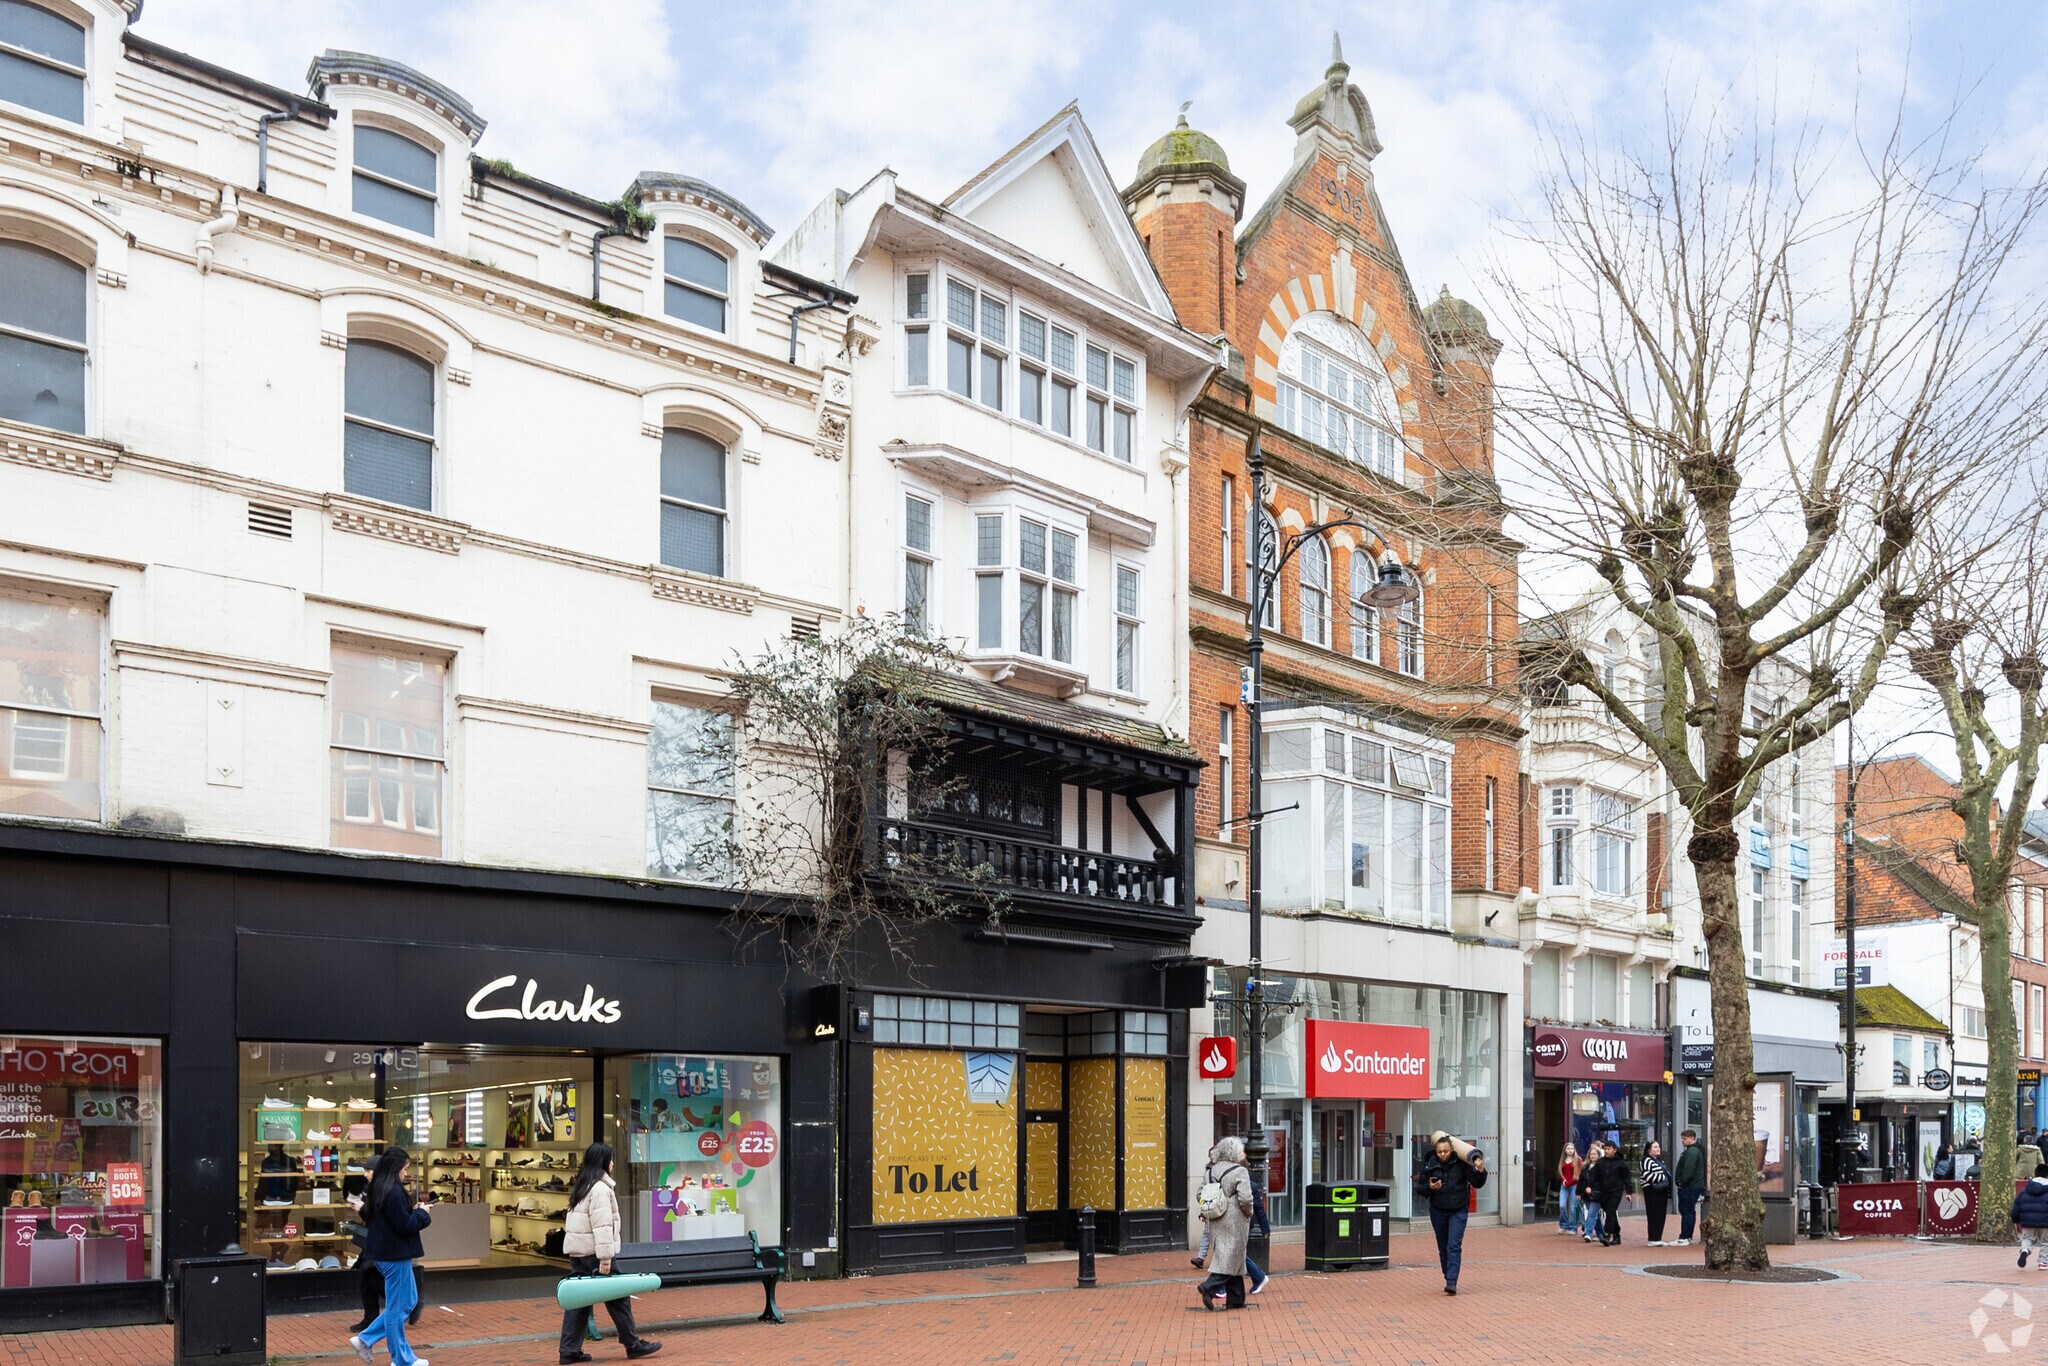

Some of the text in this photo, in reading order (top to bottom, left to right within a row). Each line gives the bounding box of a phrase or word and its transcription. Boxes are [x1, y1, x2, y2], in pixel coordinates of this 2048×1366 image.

[1321, 175, 1364, 220] 1905
[1824, 952, 1848, 961] FOR
[465, 974, 622, 1024] Clarks
[815, 1024, 835, 1036] Clarks
[1685, 1025, 1701, 1037] To
[1535, 1044, 1562, 1053] COSTA
[1584, 1037, 1628, 1061] COSTA
[1344, 1048, 1426, 1075] Santander
[1592, 1062, 1617, 1072] COFFEE
[0, 1083, 43, 1093] all the
[0, 1094, 42, 1103] boots.
[0, 1104, 42, 1113] all the
[0, 1112, 58, 1123] comfort.
[0, 1129, 37, 1139] Clarks
[701, 1140, 718, 1149] £25
[739, 1136, 775, 1153] £25
[303, 1158, 316, 1166] £10
[113, 1172, 139, 1180] BOOTS
[888, 1164, 980, 1194] To Let
[111, 1182, 142, 1199] 50%
[1853, 1199, 1903, 1212] COSTA
